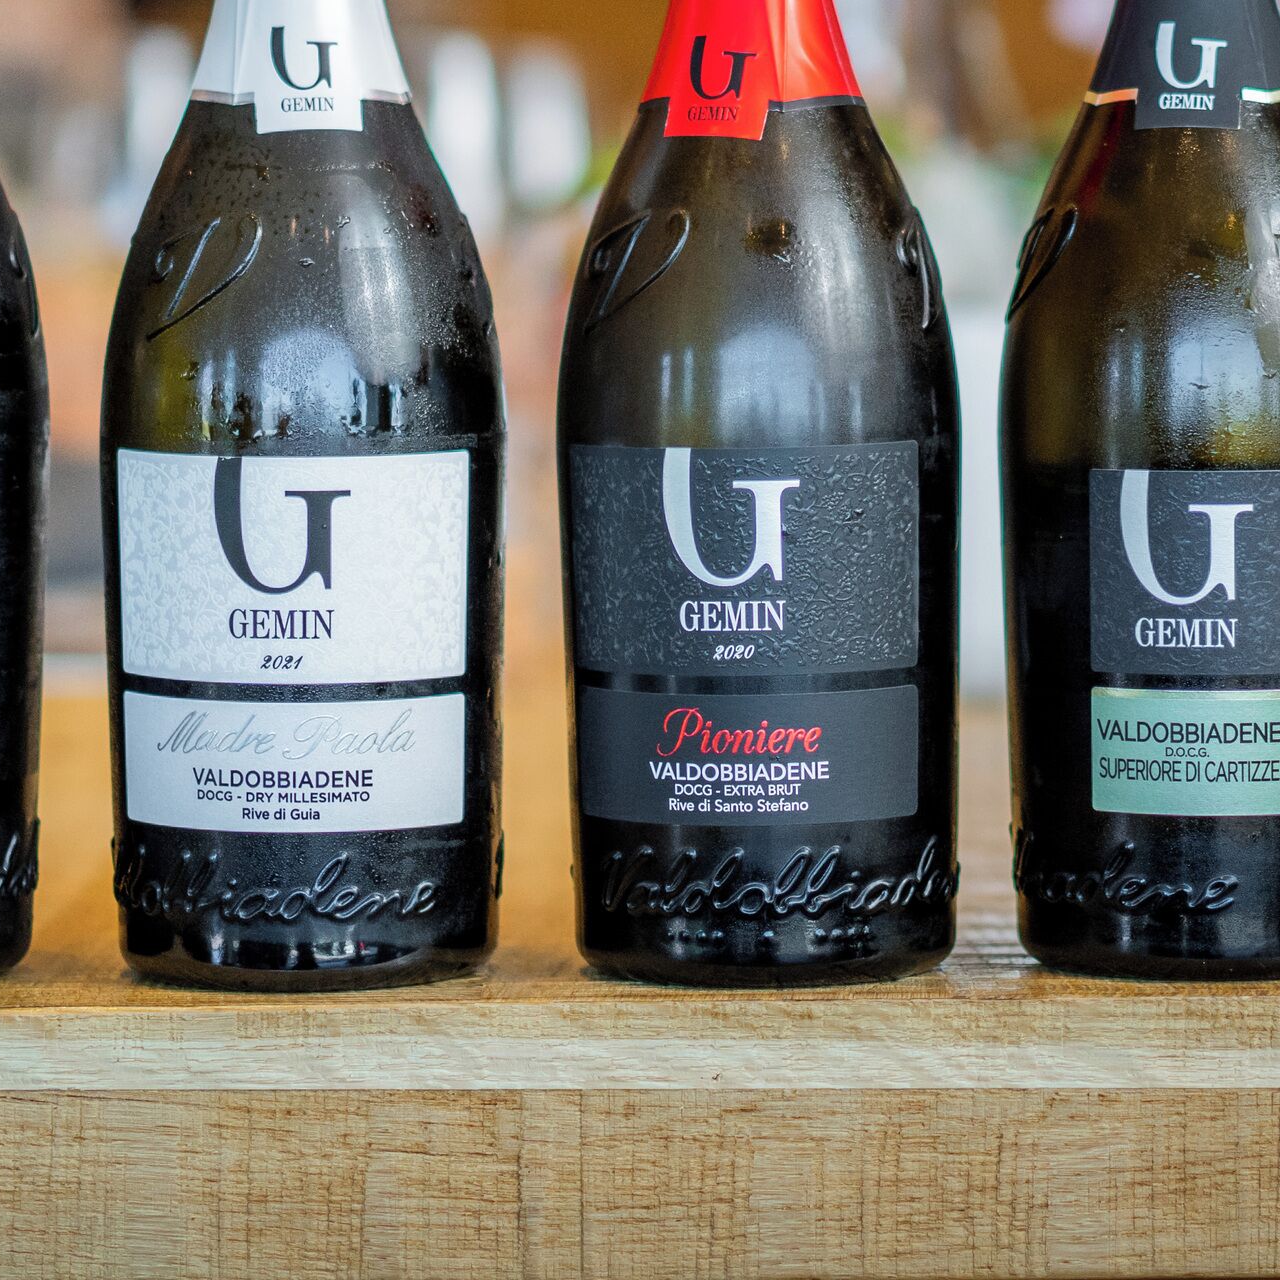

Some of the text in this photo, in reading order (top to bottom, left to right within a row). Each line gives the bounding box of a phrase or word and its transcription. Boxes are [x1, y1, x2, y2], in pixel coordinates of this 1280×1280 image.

[281, 97, 334, 112] GEMIN
[1159, 94, 1215, 111] GEMIN
[688, 106, 739, 123] GEMIN
[229, 608, 334, 640] GEMIN
[679, 601, 786, 632] GEMIN
[1135, 618, 1238, 648] GEMIN
[713, 644, 755, 661] 2020
[260, 654, 303, 670] 2021
[157, 708, 416, 760] Madre Paola
[656, 707, 822, 757] Pioniere
[1165, 747, 1209, 758] D.O.C.G.
[192, 767, 373, 789] VALDOBBIADENE
[649, 762, 830, 782] VALDOBBIADENE
[1099, 760, 1280, 782] SUPERIORE DI CARTIZZE
[197, 790, 233, 802] DOCG
[246, 791, 273, 802] DRY
[278, 791, 370, 803] MILLESIMATO
[675, 784, 712, 796] DOCG
[724, 784, 765, 796] EXTRA
[767, 784, 801, 796] BRUT
[669, 799, 809, 812] Rive di Santo Stefano
[242, 808, 320, 821] Rive di Guia
